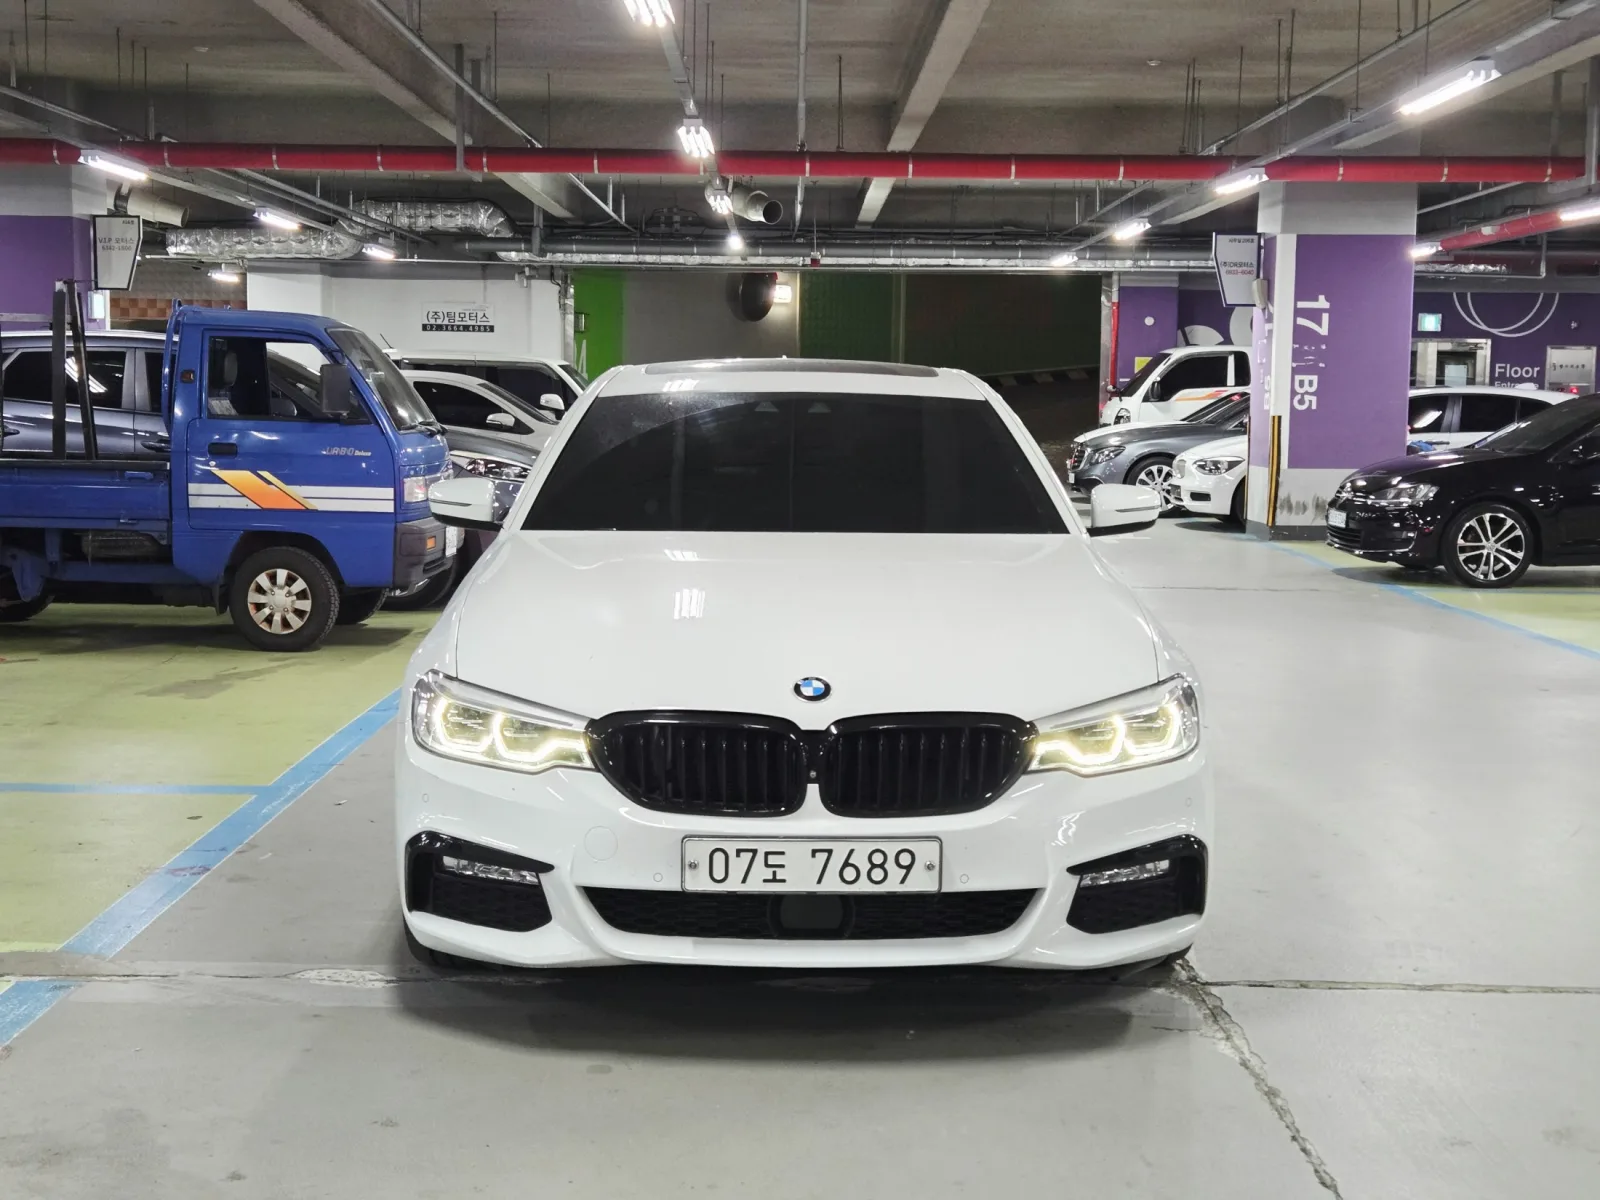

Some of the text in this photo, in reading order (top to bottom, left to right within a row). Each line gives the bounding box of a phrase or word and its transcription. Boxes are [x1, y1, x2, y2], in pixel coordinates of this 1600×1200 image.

[426, 310, 490, 323] (주)팀모터스
[1296, 295, 1330, 336] 17
[1495, 363, 1540, 378] Floor
[1293, 375, 1318, 410] B5
[1495, 381, 1539, 390] Entre
[708, 847, 916, 885] 07도 7689
